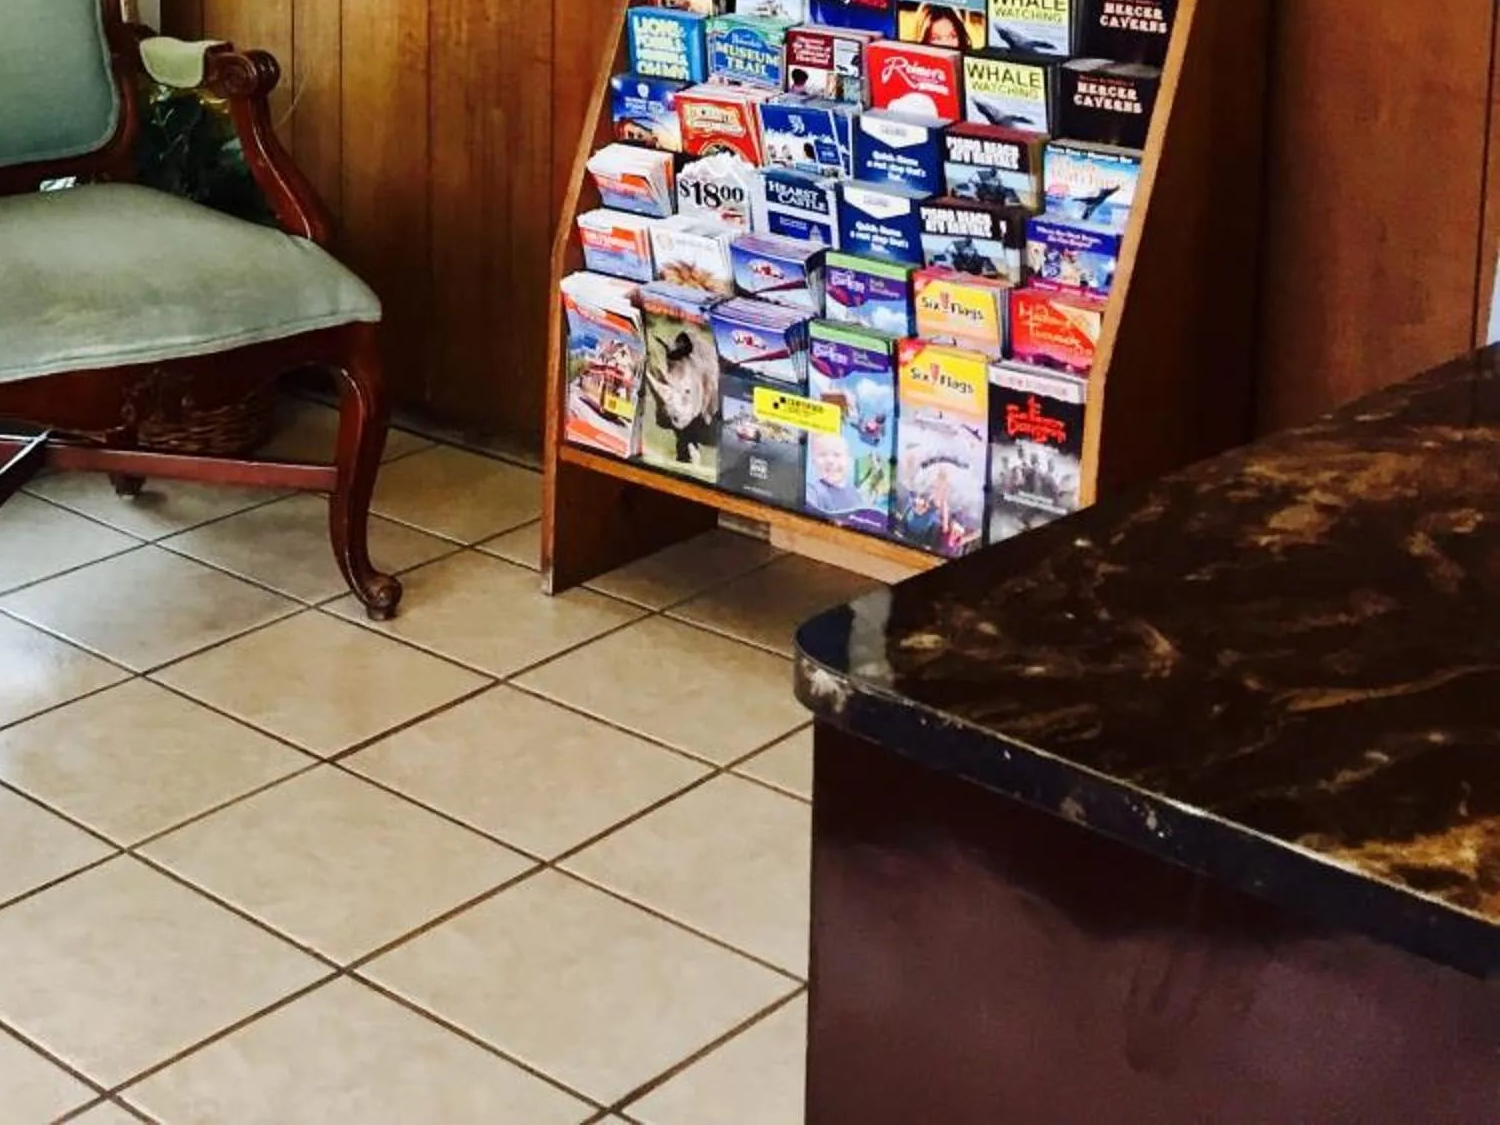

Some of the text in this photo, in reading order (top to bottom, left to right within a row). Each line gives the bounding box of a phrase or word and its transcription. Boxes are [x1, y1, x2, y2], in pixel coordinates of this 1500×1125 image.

[995, 7, 1064, 24] WATCHING
[1099, 15, 1168, 34] CAVERNS
[967, 61, 1042, 88] WHALE
[971, 81, 1040, 100] WATCHING
[1073, 94, 1143, 115] CAVERNS
[767, 180, 820, 200] HEARST
[777, 193, 827, 212] CASTLE
[921, 296, 941, 312] Six
[938, 372, 975, 395] Flags
